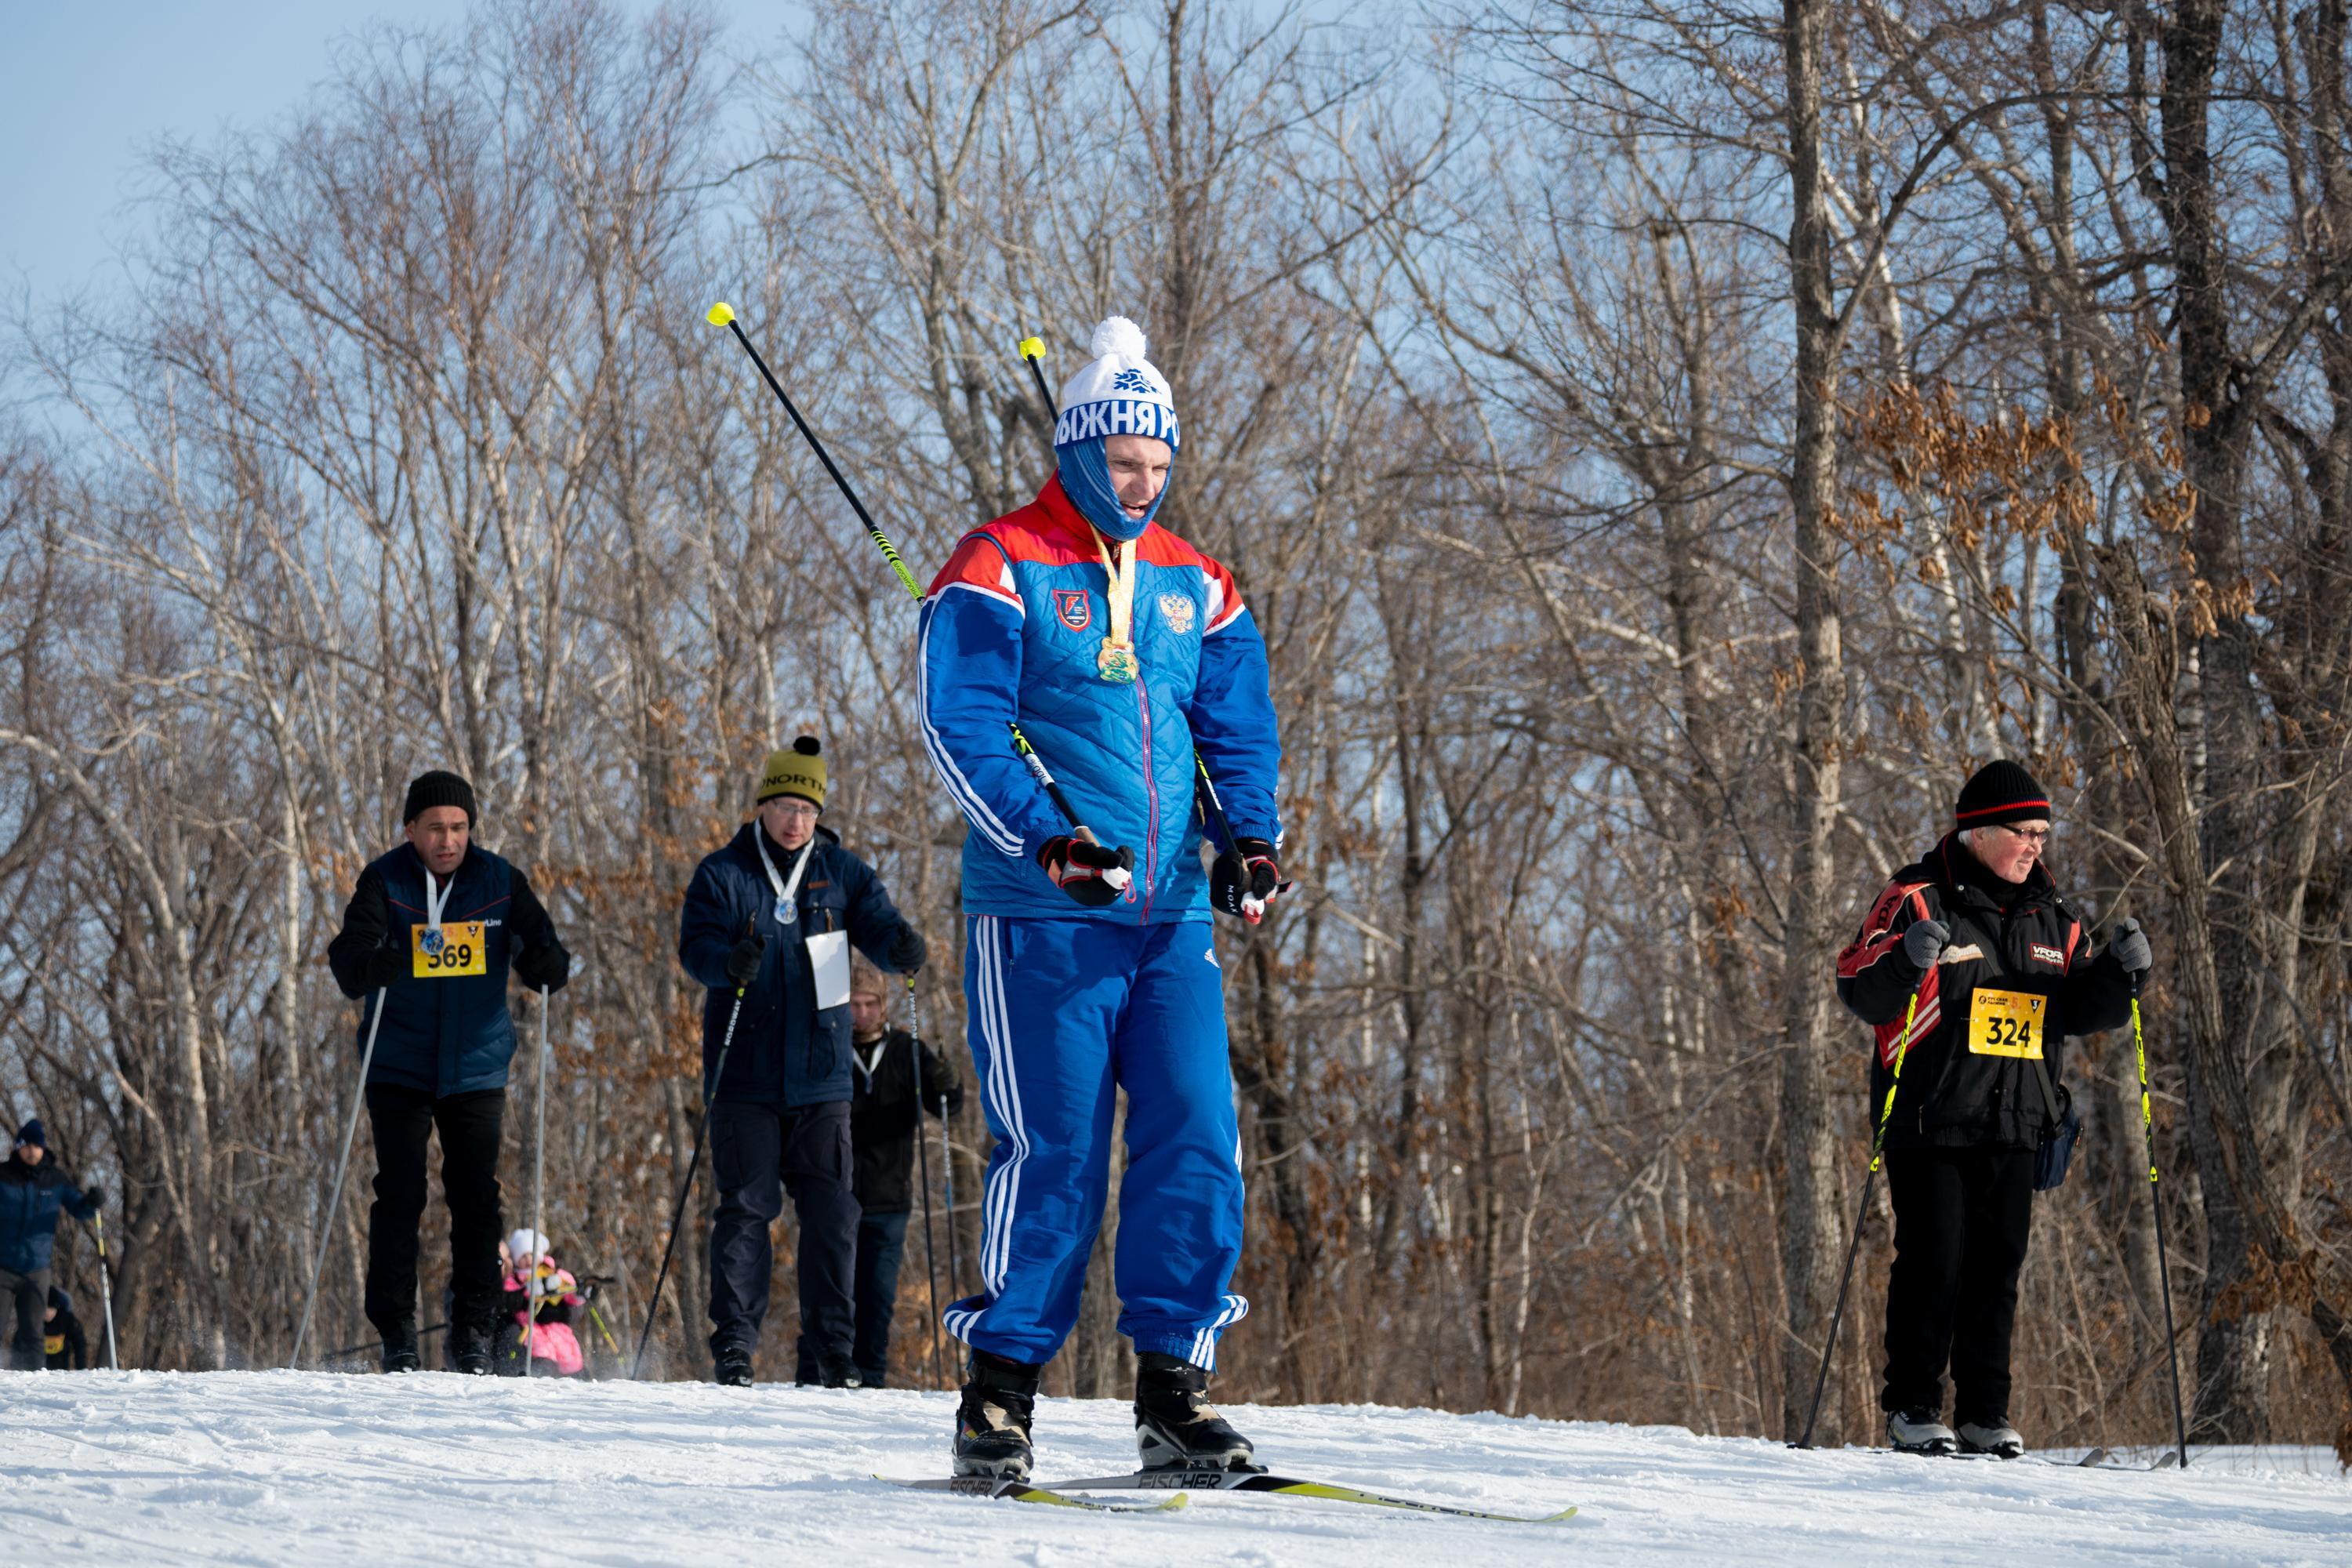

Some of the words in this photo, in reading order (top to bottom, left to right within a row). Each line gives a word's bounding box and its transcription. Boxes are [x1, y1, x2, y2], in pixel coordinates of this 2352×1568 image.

[724, 999, 742, 1047] NORDWAY
[1894, 993, 1918, 1079] FISCHER
[1986, 1016, 2031, 1048] 324
[2131, 997, 2147, 1085] FISCHER
[949, 1479, 993, 1497] FISCHER
[1138, 1473, 1222, 1490] FISCHER
